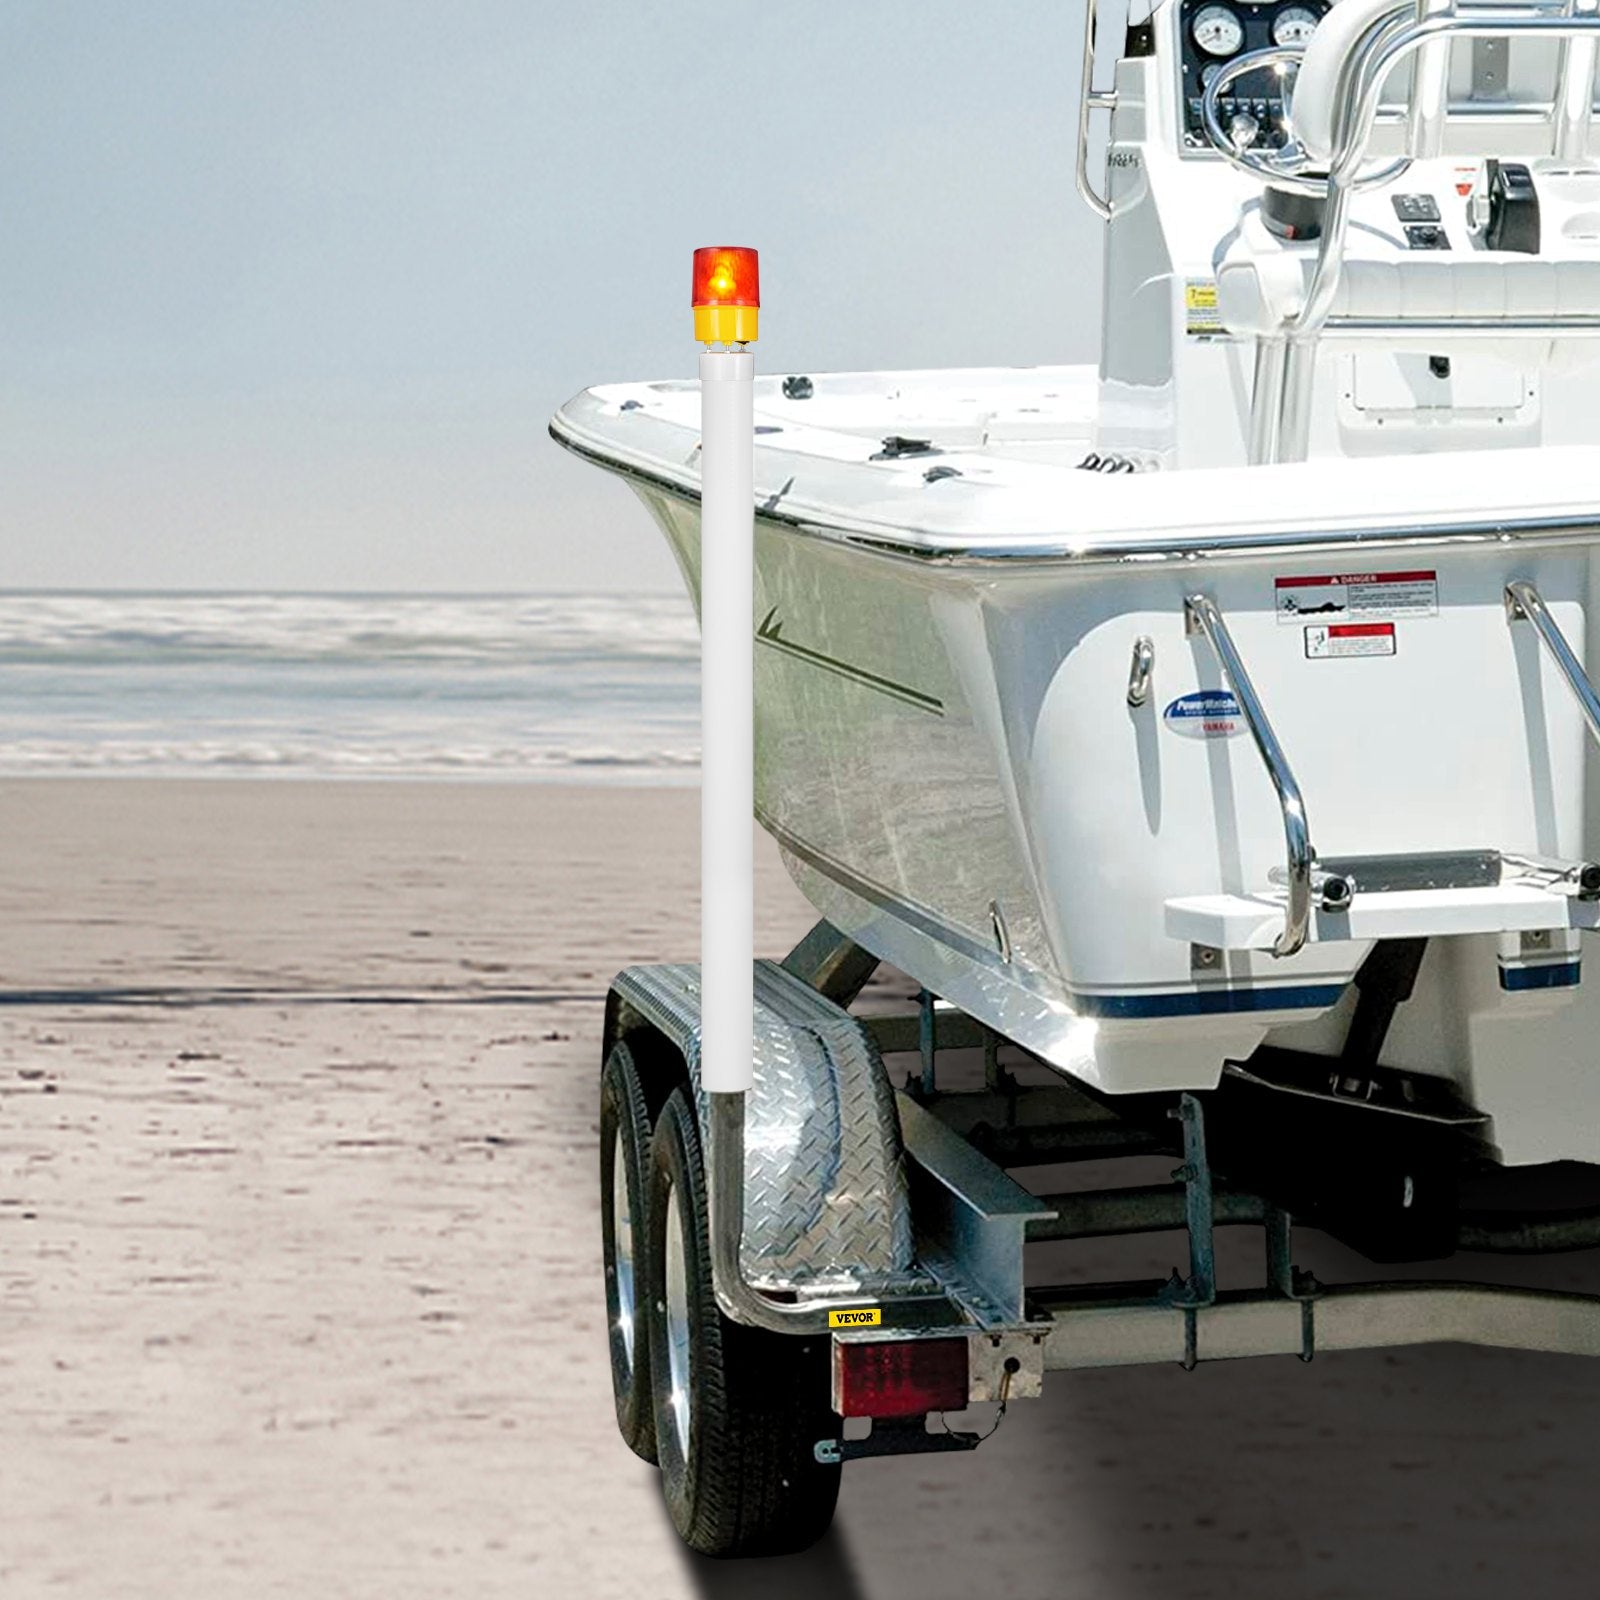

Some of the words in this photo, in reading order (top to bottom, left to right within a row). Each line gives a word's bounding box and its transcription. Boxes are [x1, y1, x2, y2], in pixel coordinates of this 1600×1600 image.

[1340, 574, 1377, 584] DANGER
[1202, 722, 1235, 732] YAMAHA
[836, 1312, 873, 1323] VEVOR
